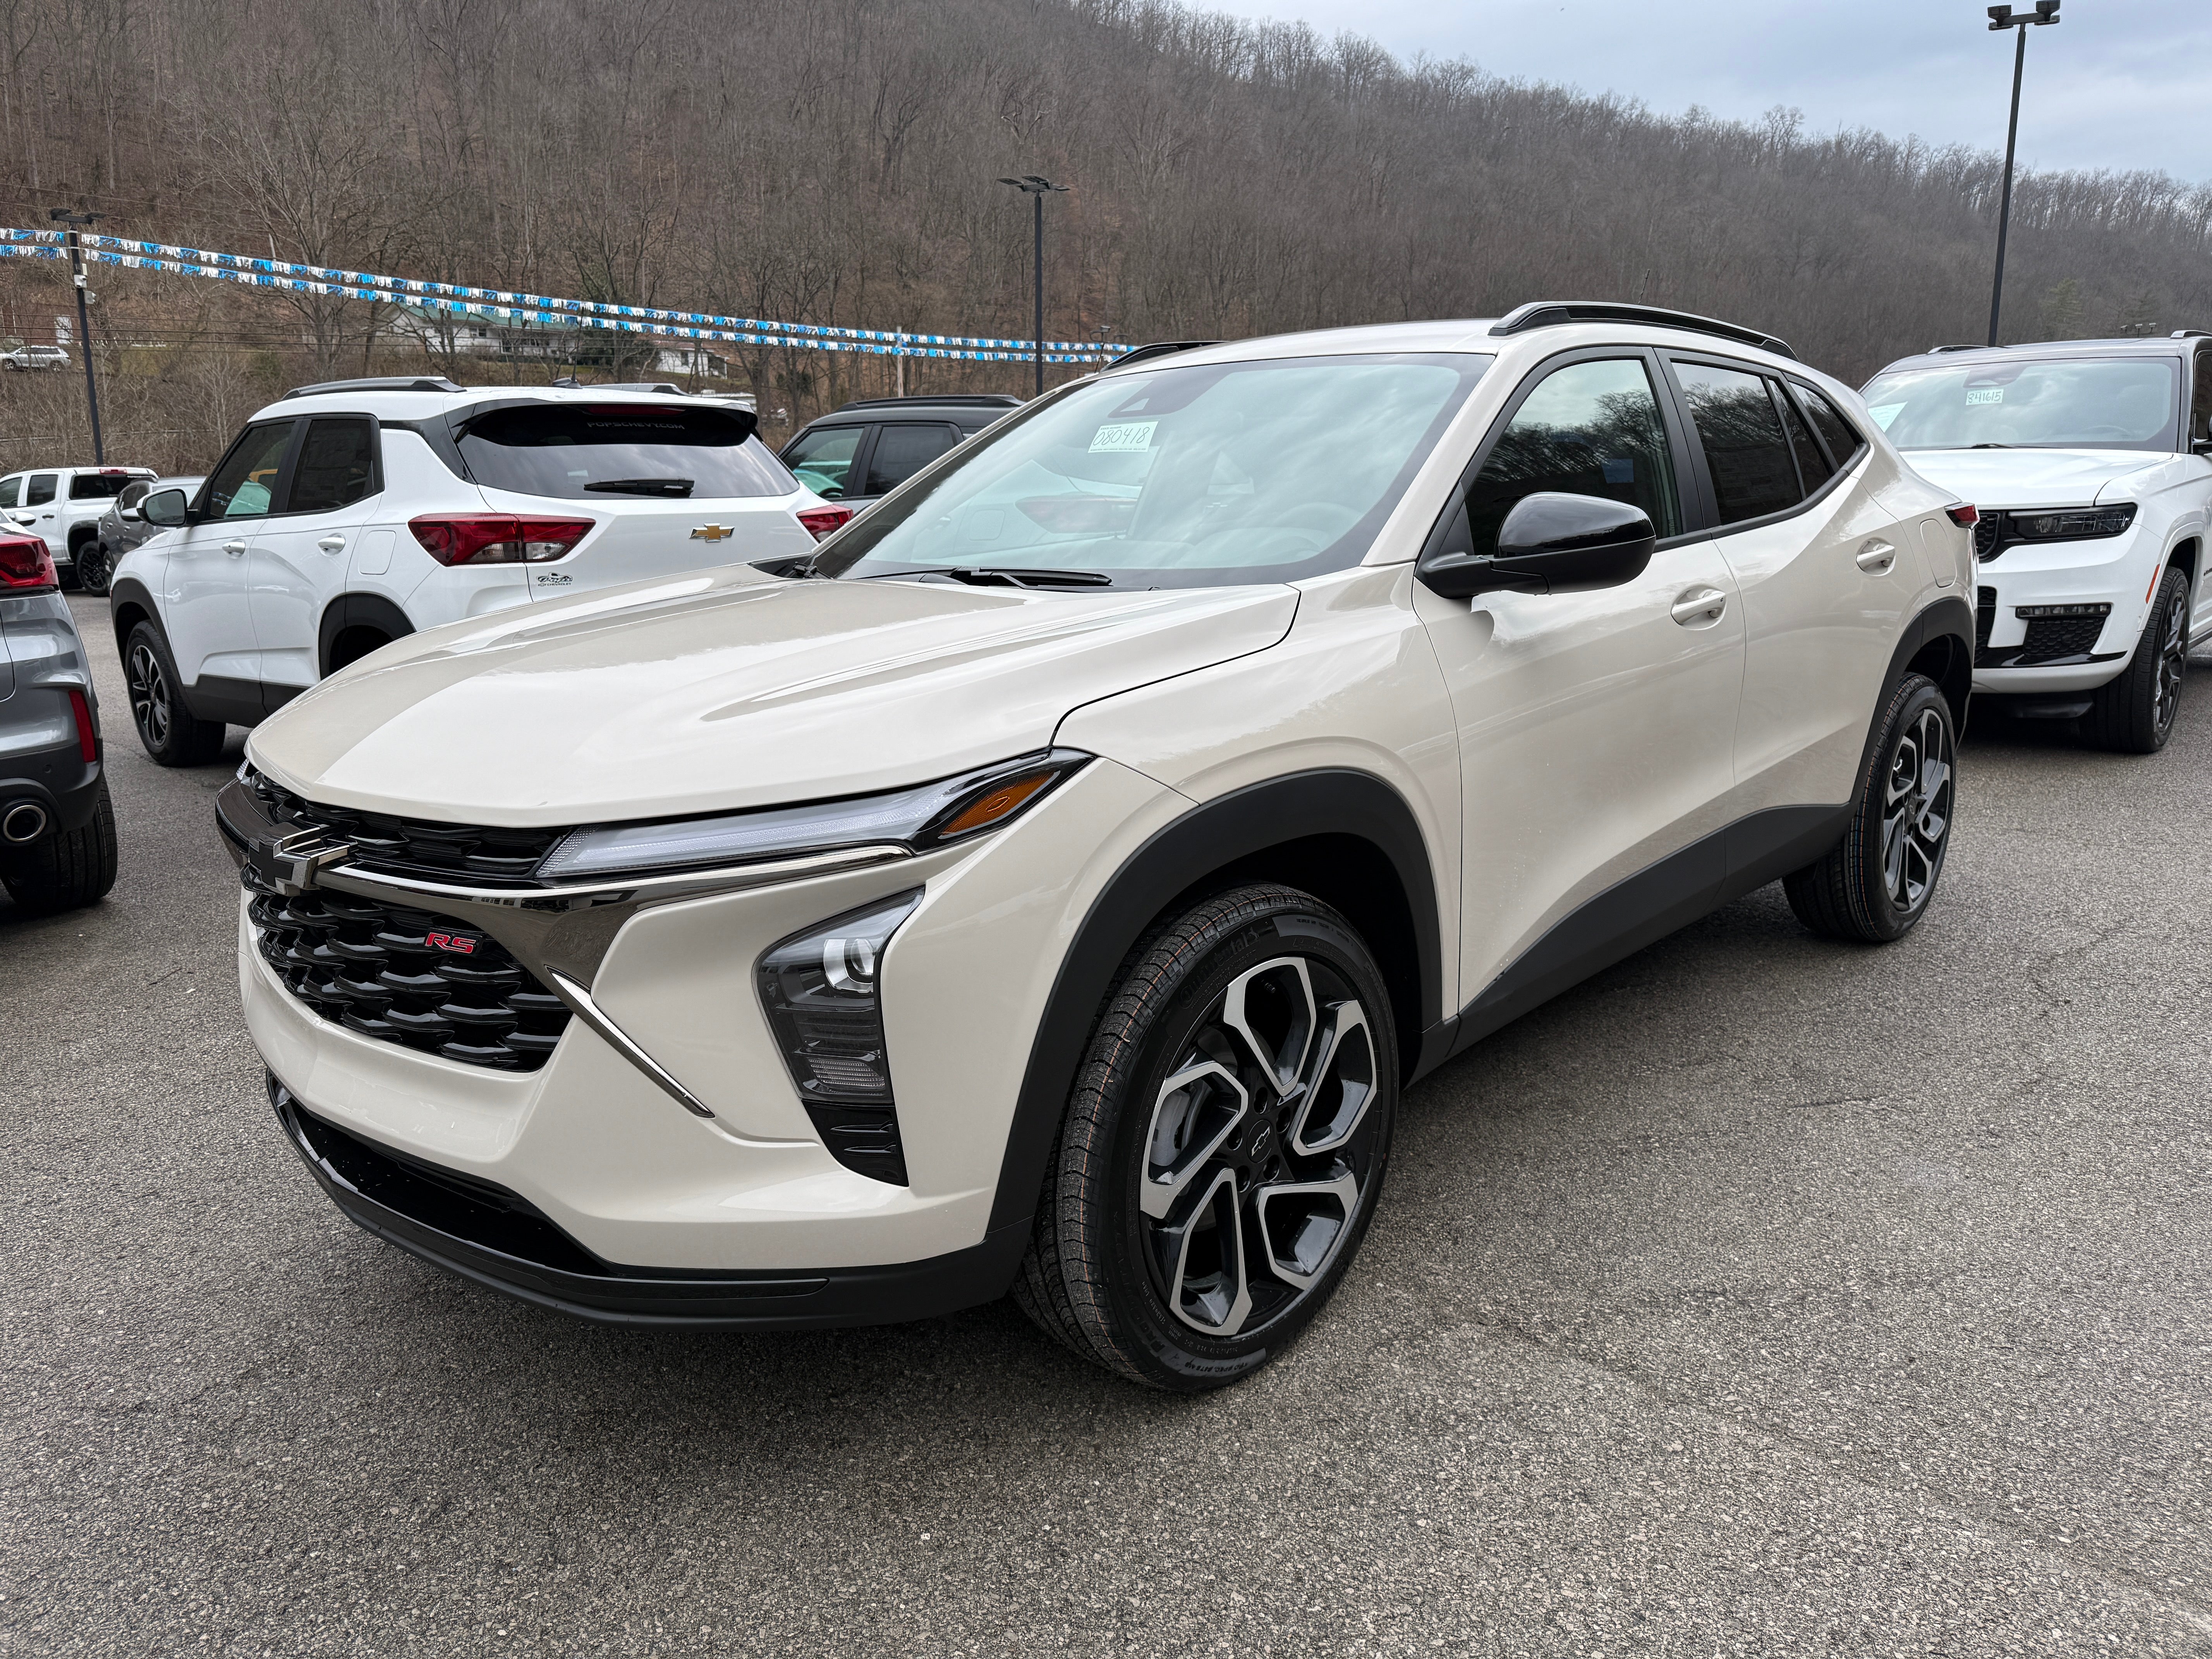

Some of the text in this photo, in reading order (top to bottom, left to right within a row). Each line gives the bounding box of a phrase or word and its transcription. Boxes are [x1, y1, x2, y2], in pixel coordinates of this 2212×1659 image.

[1968, 391, 2001, 403] 841615
[1093, 427, 1150, 446] 080418
[424, 932, 476, 954] RS
